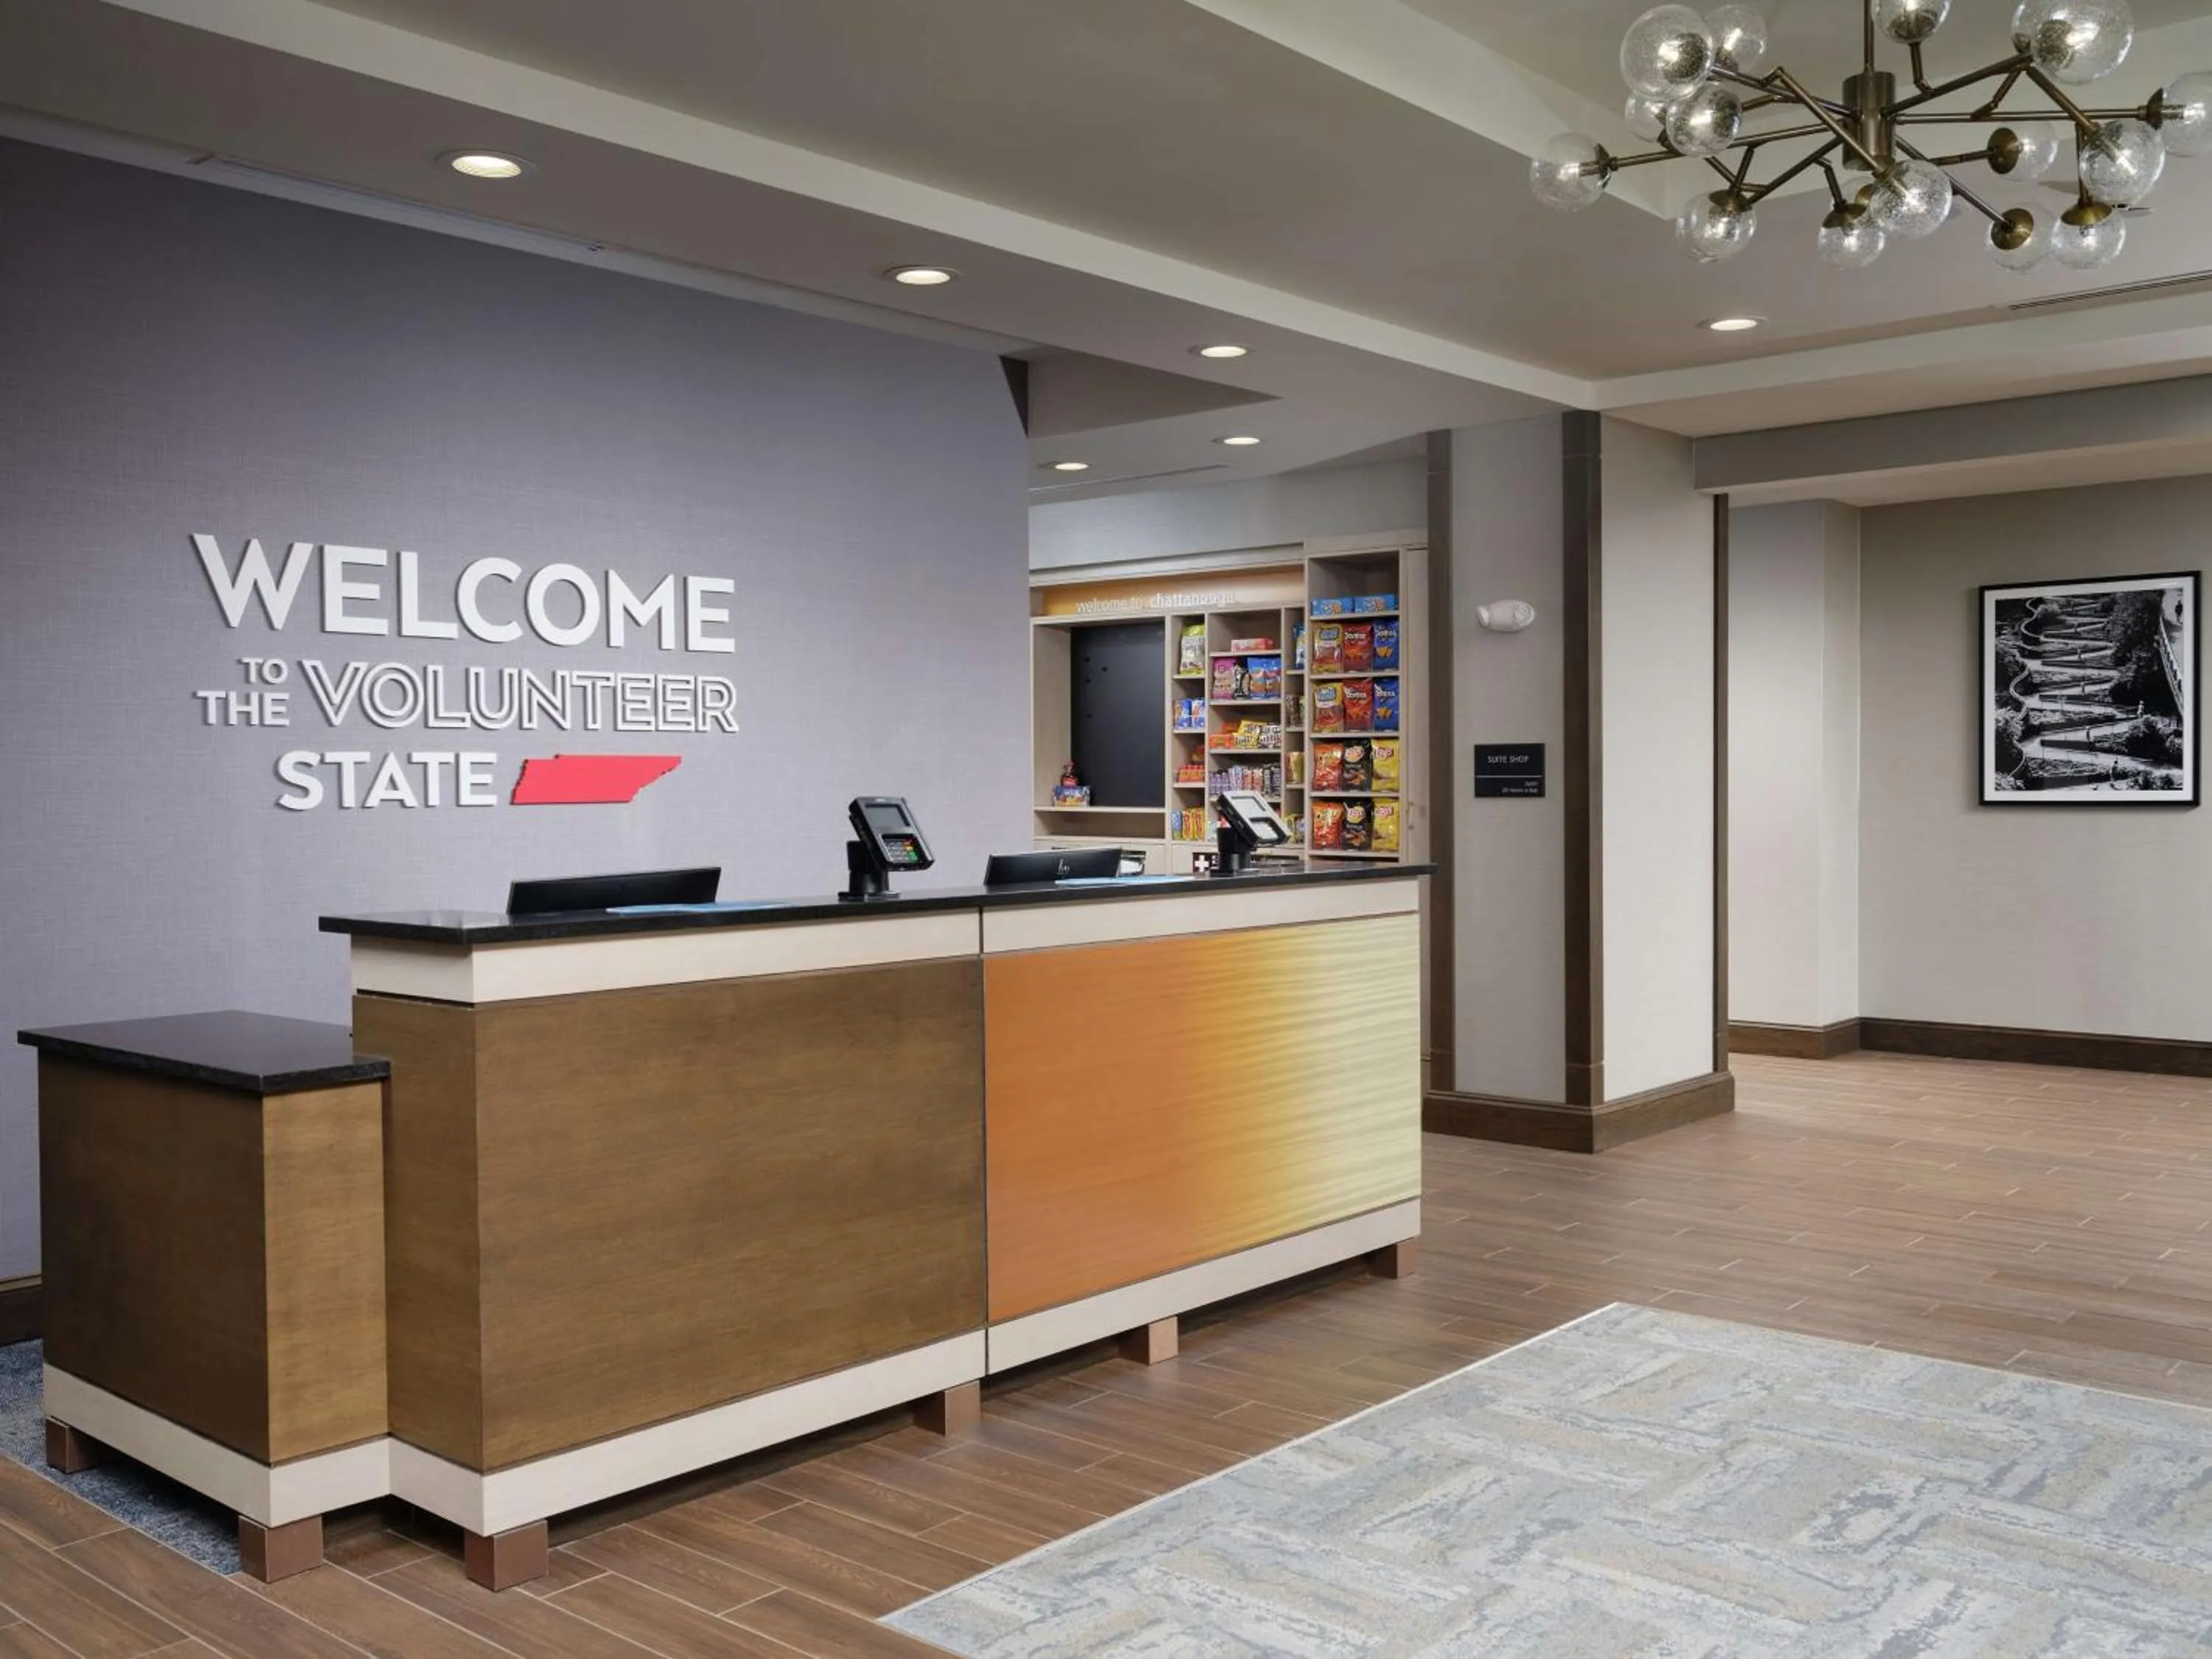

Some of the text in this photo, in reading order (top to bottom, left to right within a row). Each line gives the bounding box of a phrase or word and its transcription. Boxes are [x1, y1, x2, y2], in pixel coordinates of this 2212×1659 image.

[189, 533, 736, 653] WELCOME
[195, 660, 739, 733] THE VOLUNTEER
[240, 657, 288, 685] TO
[276, 750, 498, 811] STATE
[1486, 754, 1530, 764] SUITE SHOP
